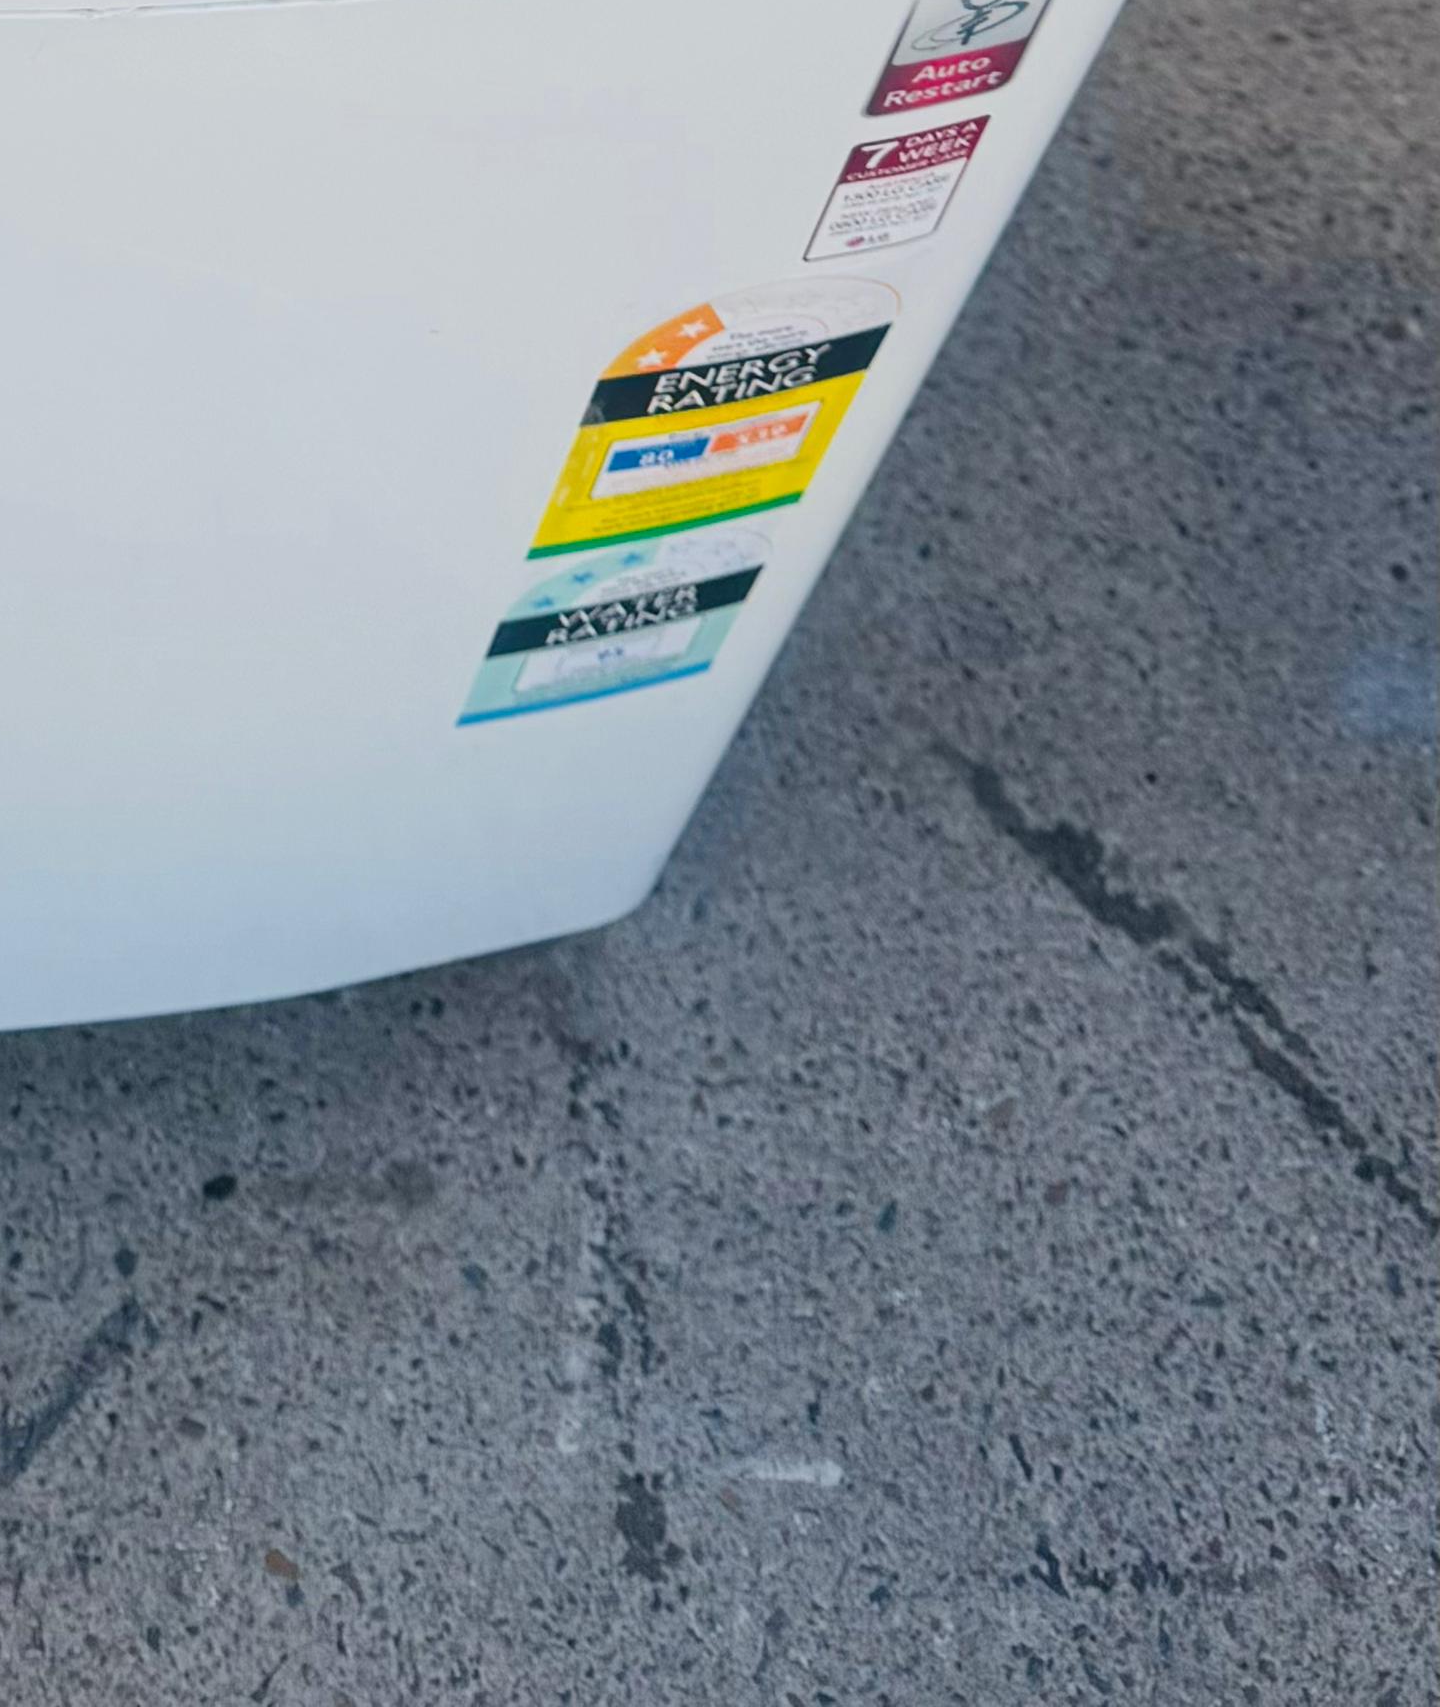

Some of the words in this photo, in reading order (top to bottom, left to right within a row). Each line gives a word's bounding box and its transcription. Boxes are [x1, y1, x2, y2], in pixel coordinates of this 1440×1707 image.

[911, 57, 992, 84] Auto
[883, 72, 1003, 108] Restart
[860, 141, 899, 170] 7
[898, 135, 972, 163] WEEK
[653, 343, 832, 393] ENERGY
[646, 366, 818, 415] RATING
[545, 604, 697, 646] RATING
